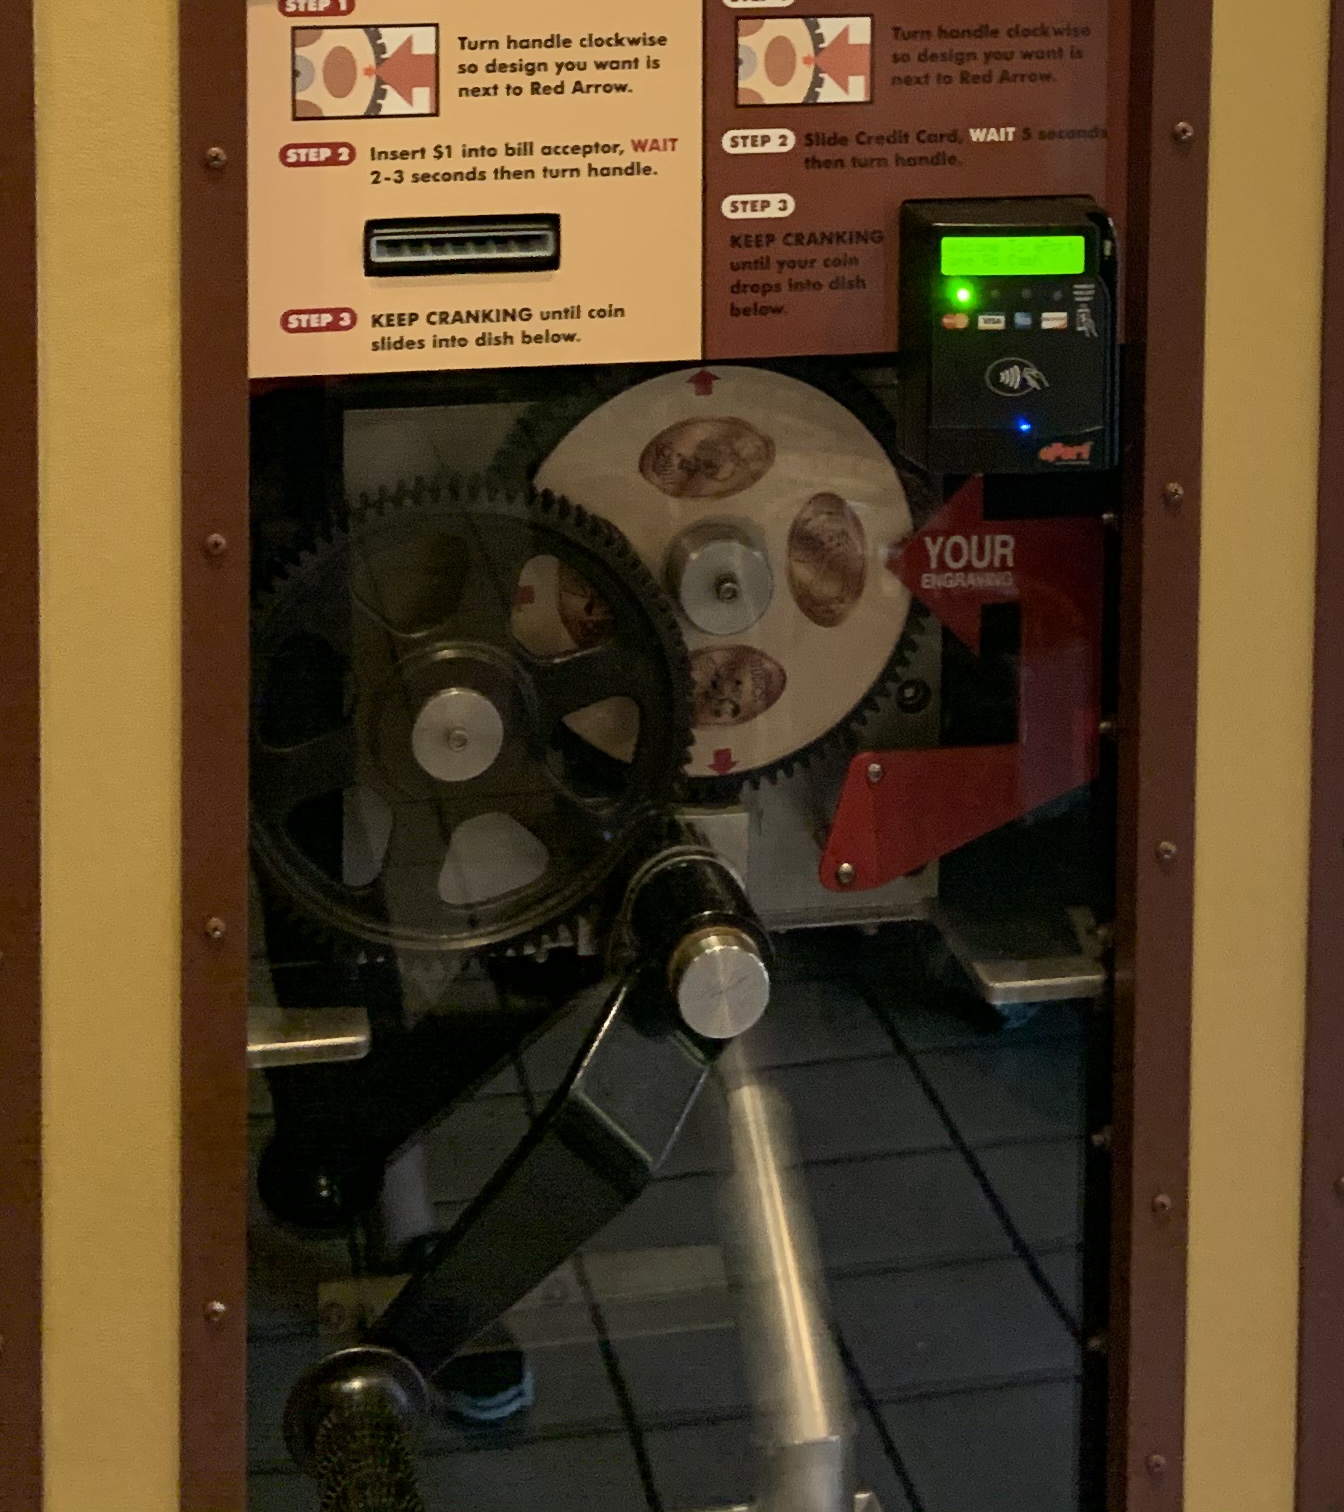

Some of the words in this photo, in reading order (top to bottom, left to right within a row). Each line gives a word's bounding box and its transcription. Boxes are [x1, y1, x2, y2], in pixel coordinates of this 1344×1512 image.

[458, 35, 500, 51] Turn
[506, 33, 572, 50] handle
[579, 32, 668, 49] clockwise
[891, 27, 932, 41] Turn
[937, 24, 1000, 39] handle
[1006, 23, 1091, 39] clockwise
[458, 61, 478, 75] so
[485, 57, 548, 77] design
[554, 60, 588, 77] you
[594, 57, 640, 72] want
[646, 55, 661, 70] is
[891, 51, 911, 64] so
[917, 47, 978, 66] design
[984, 50, 1015, 67] you
[1020, 46, 1064, 61] want
[1069, 45, 1084, 59] is
[891, 73, 932, 87] next
[936, 71, 954, 85] to
[960, 69, 994, 85] Red
[999, 69, 1056, 84] Arrow.
[458, 82, 500, 98] next
[506, 82, 523, 97] to
[530, 80, 565, 96] Red
[571, 79, 633, 95] Arrow.
[730, 134, 771, 148] STEP
[778, 134, 789, 148] 2
[804, 132, 850, 147] Slide
[855, 129, 910, 146] Credit
[969, 127, 1016, 142] WAIT
[1022, 127, 1032, 141] 5
[286, 148, 331, 163] STEP
[340, 147, 350, 162] 2
[370, 146, 426, 162] Insert
[432, 144, 453, 162] $1
[461, 143, 498, 159] into
[503, 141, 533, 158] bill
[541, 141, 625, 160] acceptor,
[631, 138, 679, 153] WAIT
[804, 155, 844, 170] then
[850, 154, 888, 168] turn
[894, 152, 962, 168] handle.
[370, 170, 404, 185] 2-3
[411, 165, 486, 184] seconds
[492, 164, 536, 181] then
[542, 164, 580, 179] turn
[586, 161, 658, 178] handle.
[730, 199, 771, 213] STEP
[778, 199, 789, 212] 3
[730, 232, 775, 249] KEEP
[782, 230, 884, 246] CRANKING
[730, 256, 771, 271] until
[776, 257, 817, 273] your
[823, 254, 859, 268] coin
[730, 281, 783, 298] drops
[788, 278, 823, 292] into
[829, 276, 866, 291] dish
[287, 312, 333, 327] STEP
[341, 311, 352, 326] 3
[371, 312, 419, 329] KEEP
[426, 308, 533, 327] CRANKING
[540, 305, 581, 321] until
[588, 304, 625, 319] coin
[730, 301, 788, 317] below.
[371, 334, 426, 351] slides
[432, 334, 468, 349] into
[475, 331, 515, 347] dish
[521, 329, 581, 345] below.
[924, 534, 1015, 569] YOUR
